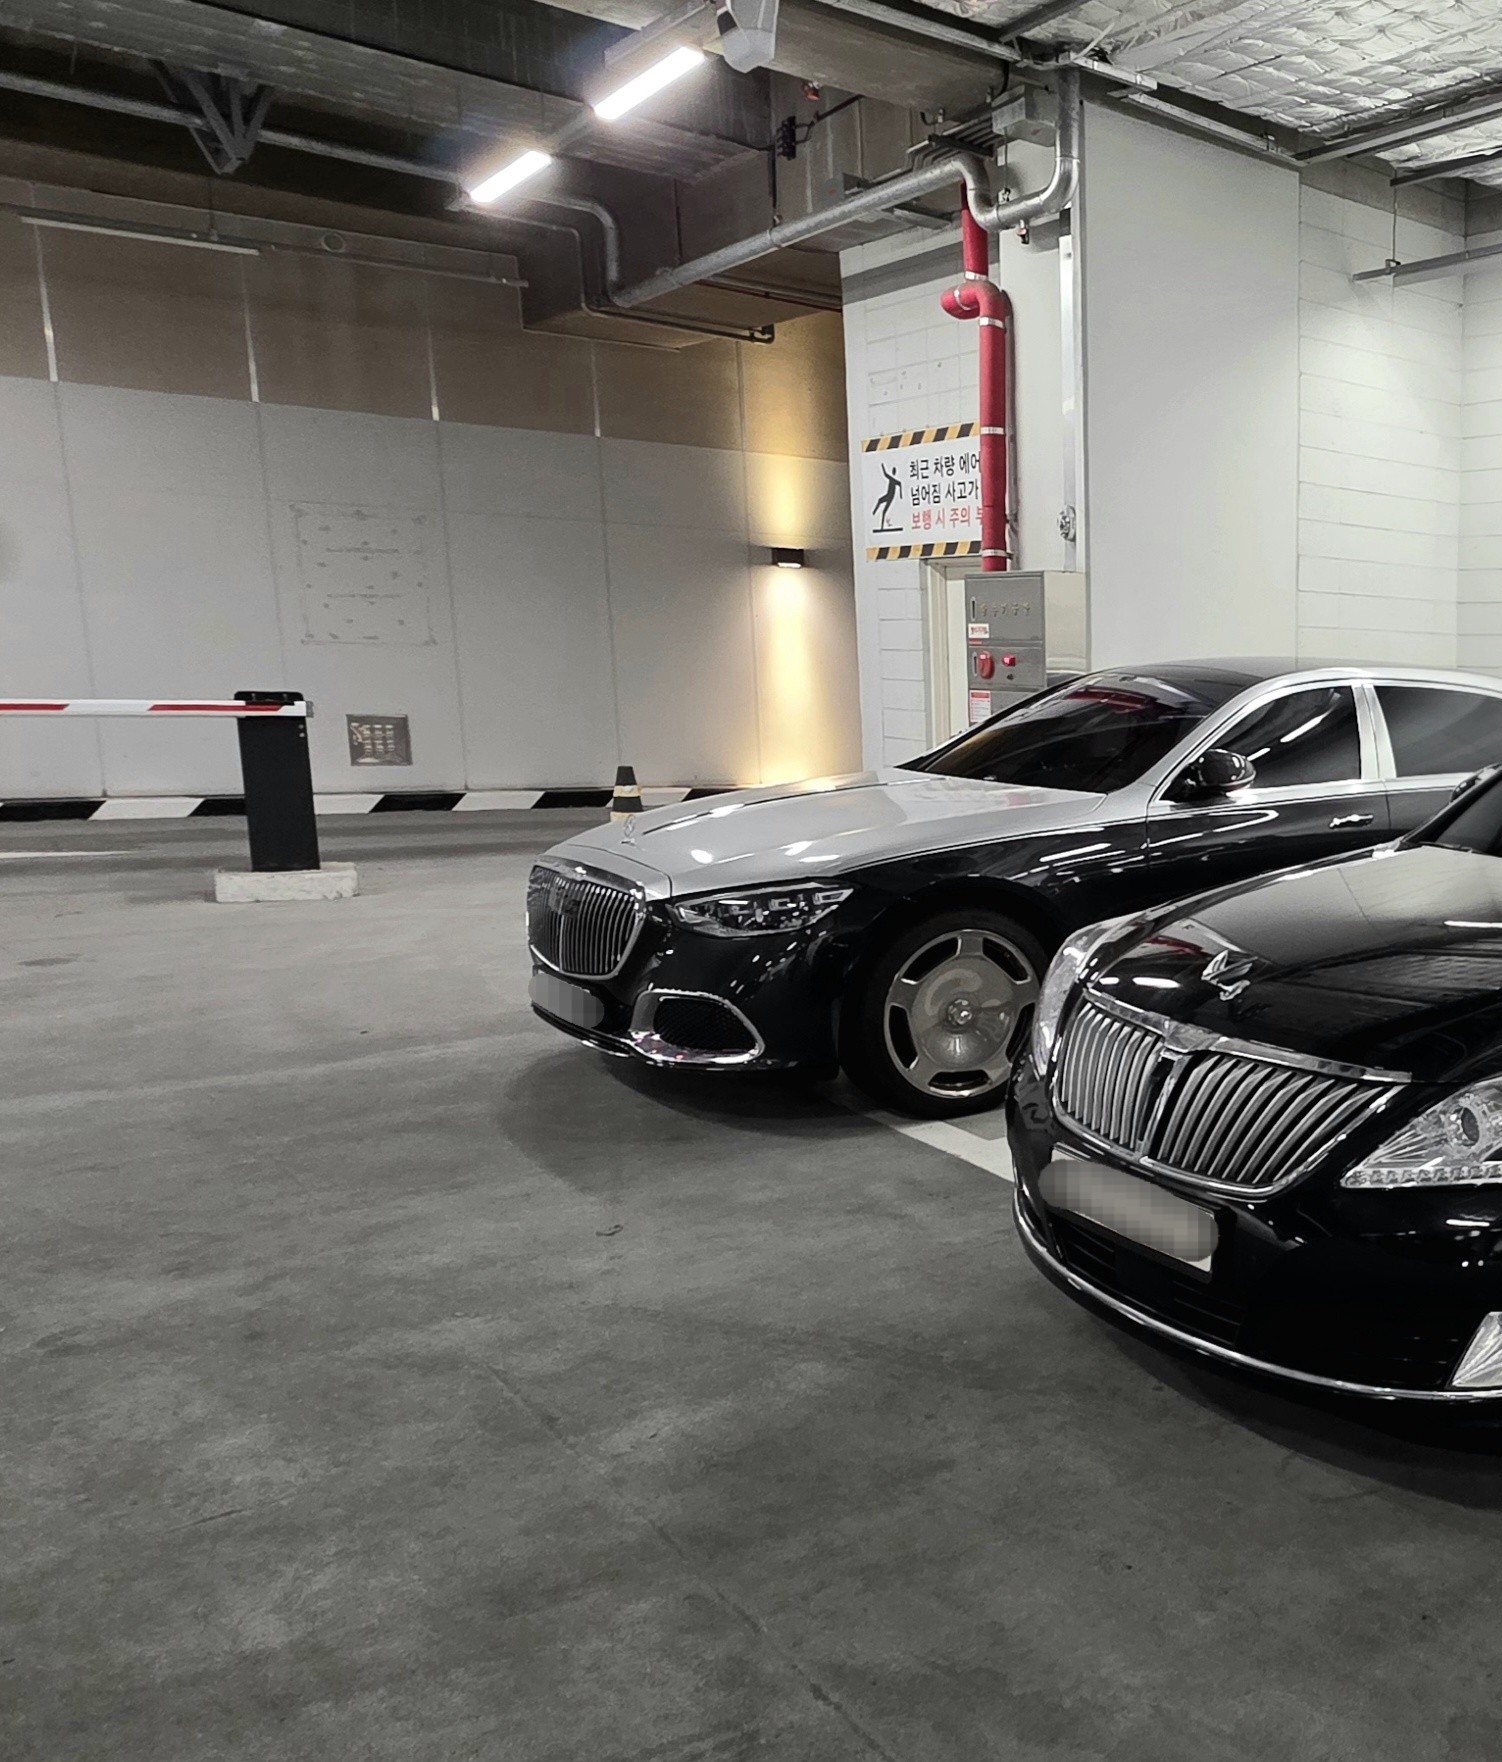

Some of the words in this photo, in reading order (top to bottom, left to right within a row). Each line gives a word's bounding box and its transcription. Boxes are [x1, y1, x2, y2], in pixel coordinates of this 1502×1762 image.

[910, 459, 929, 480] 최근
[933, 454, 955, 477] 차량
[910, 482, 941, 507] 넘어짐
[945, 478, 979, 502] 사고가
[935, 507, 945, 528] 시
[949, 505, 971, 528] 주의
